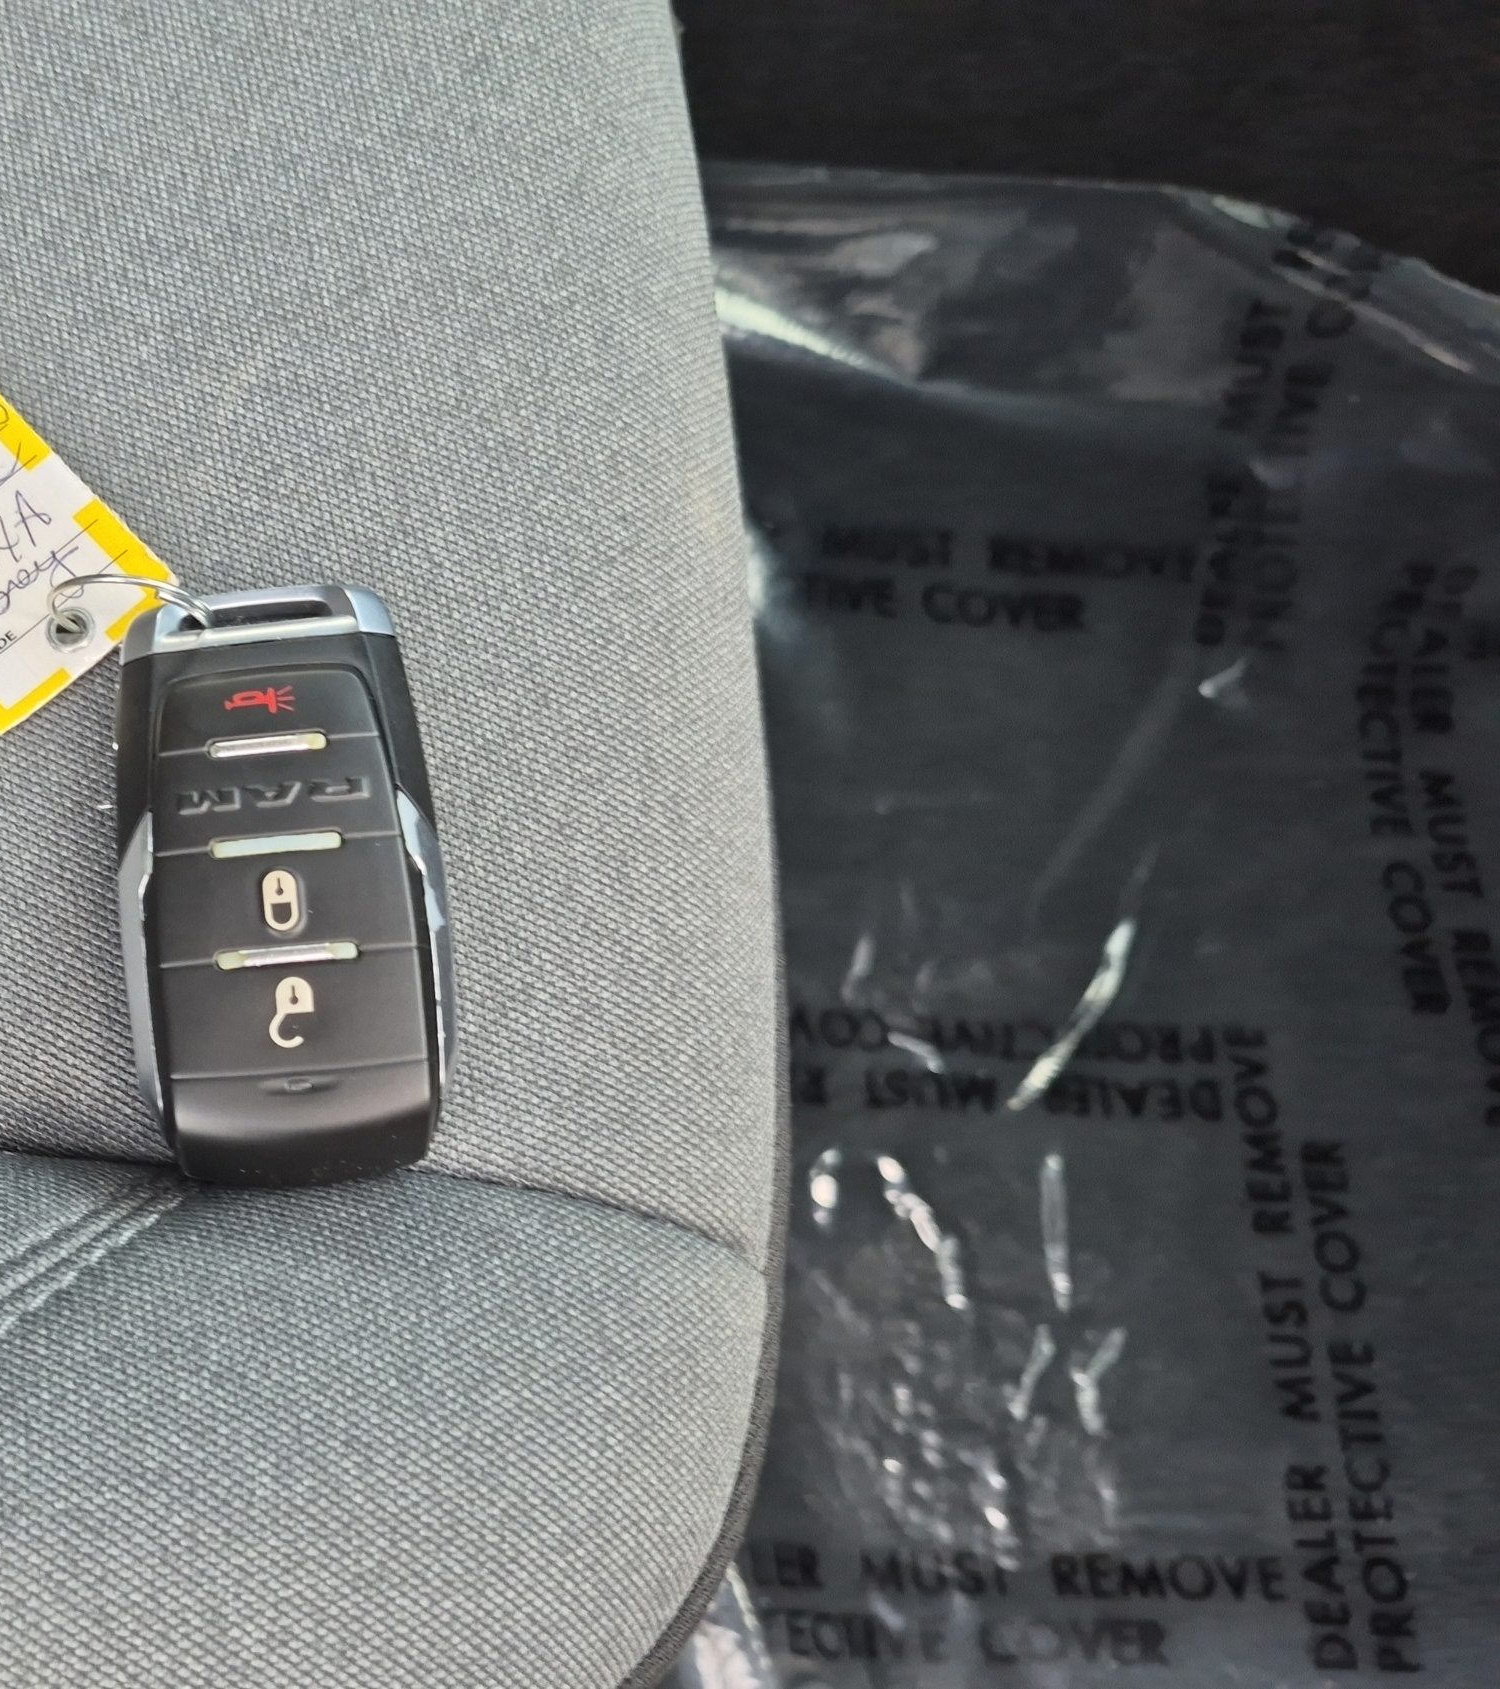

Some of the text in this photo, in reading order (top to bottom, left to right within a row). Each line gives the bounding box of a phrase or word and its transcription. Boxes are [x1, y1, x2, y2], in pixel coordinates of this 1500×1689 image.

[1218, 297, 1291, 434] MUST
[821, 525, 1197, 583] MUST REMOVE
[921, 581, 1087, 633] COVER
[1409, 563, 1481, 736] DEALER
[177, 776, 372, 815] RAM
[1355, 562, 1453, 1016] PROTECTIVE COVER
[1416, 769, 1484, 900] MUST
[862, 1069, 998, 1115] MUST
[1221, 1022, 1359, 1671] DEALER MUST REMOVE
[1300, 1138, 1427, 1674] PROTECTIVE COVER
[859, 1547, 1011, 1596] MUST
[1049, 1552, 1288, 1602] REMOVE
[977, 1614, 1172, 1668] COVER
